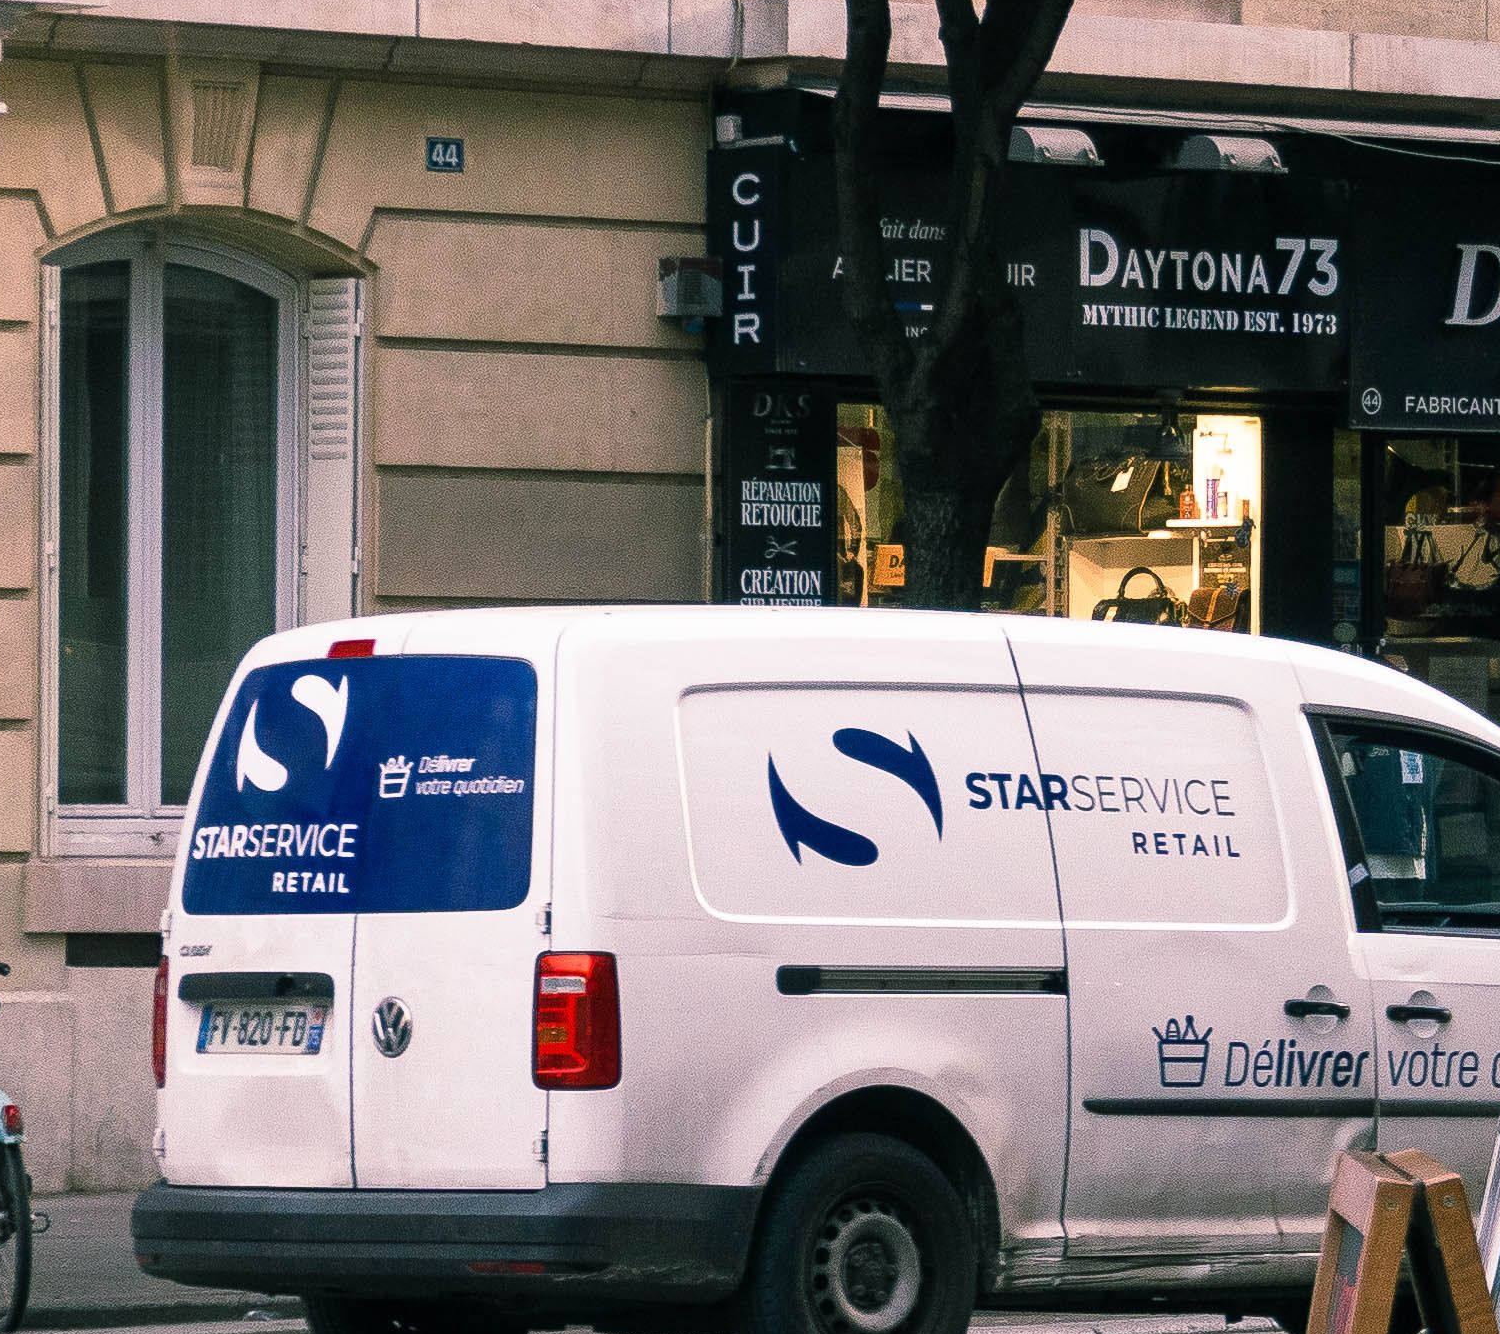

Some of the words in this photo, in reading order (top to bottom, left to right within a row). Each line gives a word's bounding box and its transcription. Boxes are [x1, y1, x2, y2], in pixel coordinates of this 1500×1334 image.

[431, 143, 459, 167] 44
[731, 172, 763, 346] CUIR
[1081, 303, 1161, 329] MYTHIC
[1164, 307, 1239, 332] LEGEND
[1243, 310, 1286, 334] EST.
[1292, 312, 1338, 336] 1973
[740, 476, 822, 504] RÉPARATION
[740, 502, 823, 528] RETOUCHE
[739, 565, 823, 597] CRÉATION
[417, 754, 476, 774] Délivrer
[416, 778, 451, 795] votre
[453, 775, 525, 797] quotidien
[965, 771, 1236, 817] STARSERVICE
[191, 823, 359, 860] STARSERVICE
[1131, 831, 1241, 858] RETAIL
[271, 871, 351, 894] RETAIL
[1224, 1039, 1371, 1089] Délivrer
[1388, 1043, 1480, 1089] votre
